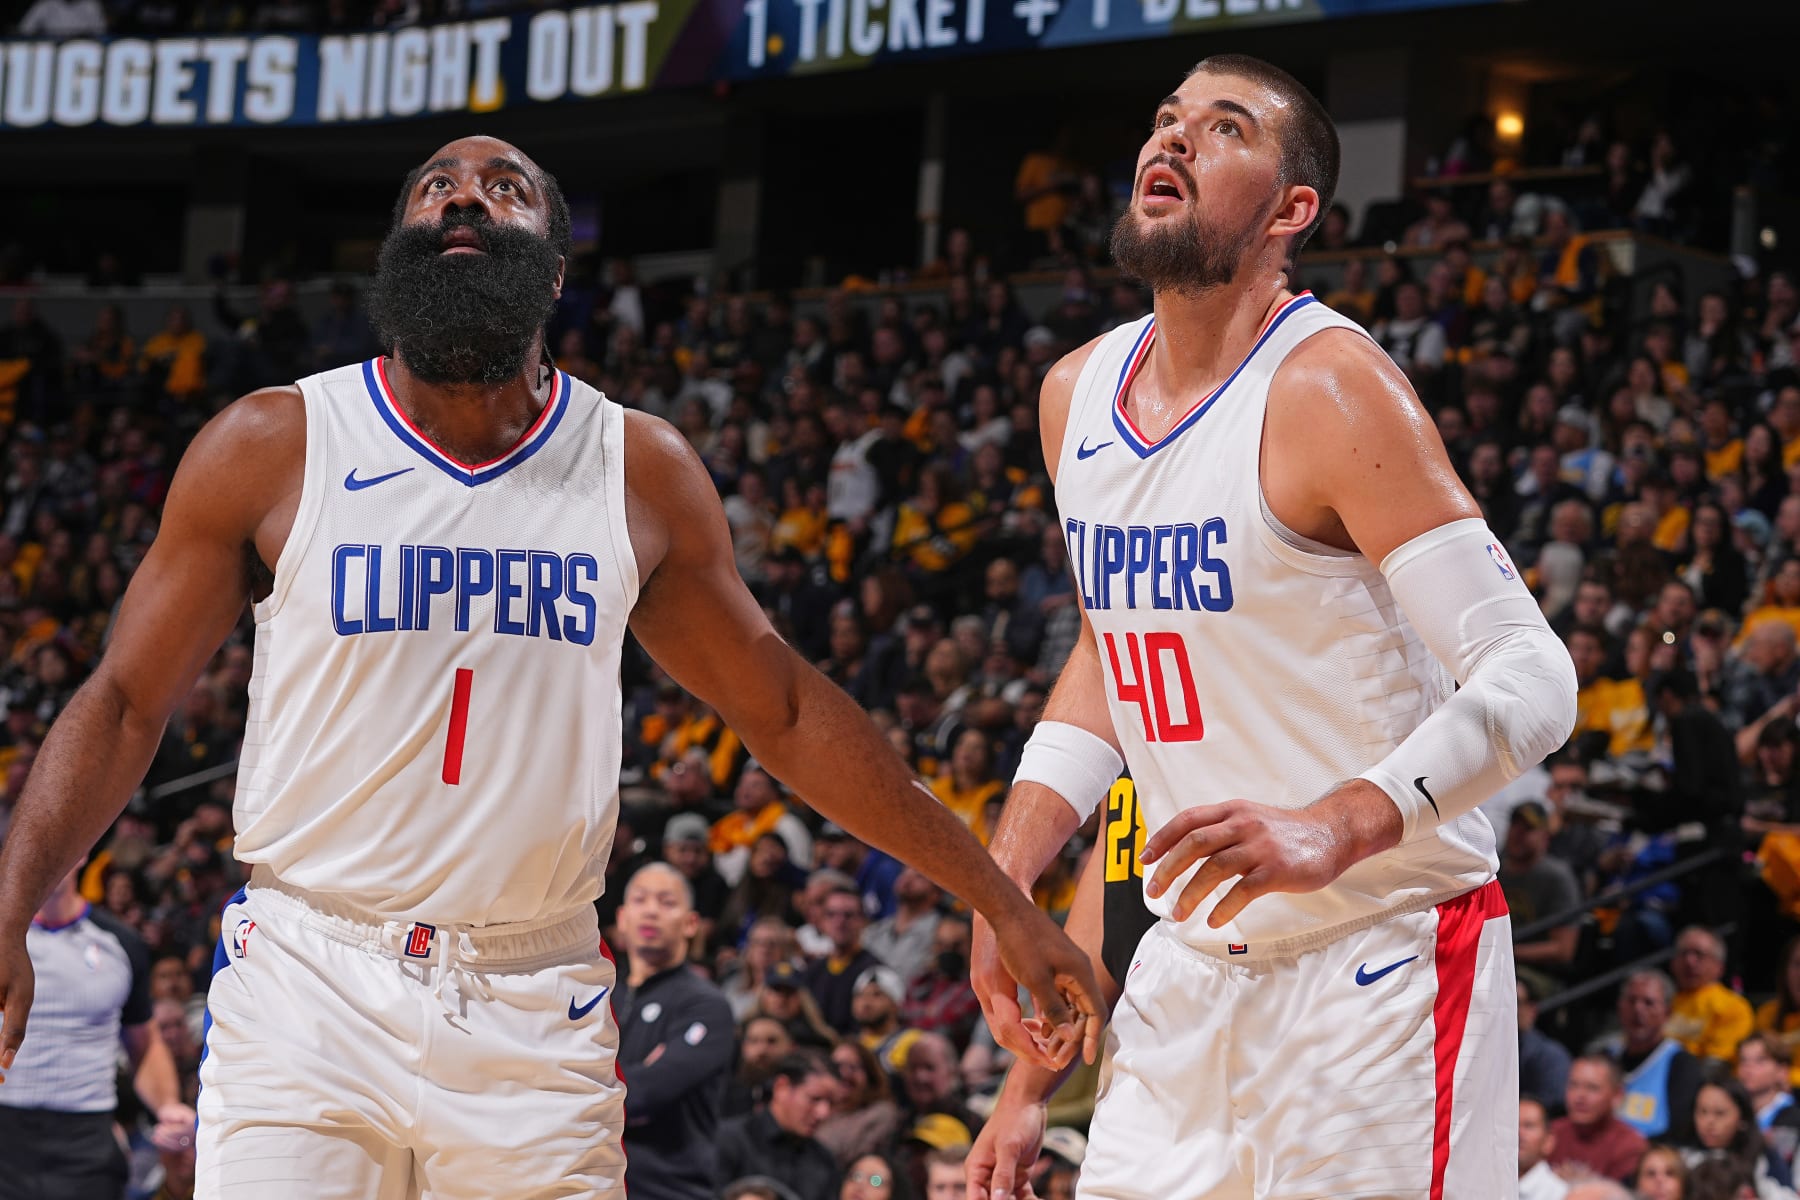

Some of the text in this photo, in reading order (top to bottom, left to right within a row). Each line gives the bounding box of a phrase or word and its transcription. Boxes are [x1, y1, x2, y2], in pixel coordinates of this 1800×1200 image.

[0, 2, 659, 126] UGGETS NIGHT OUT
[744, 0, 767, 67] 1
[796, 0, 985, 61] TICKET
[331, 544, 598, 646] CLIPPERS
[442, 668, 474, 786] 1
[1103, 632, 1204, 743] 40
